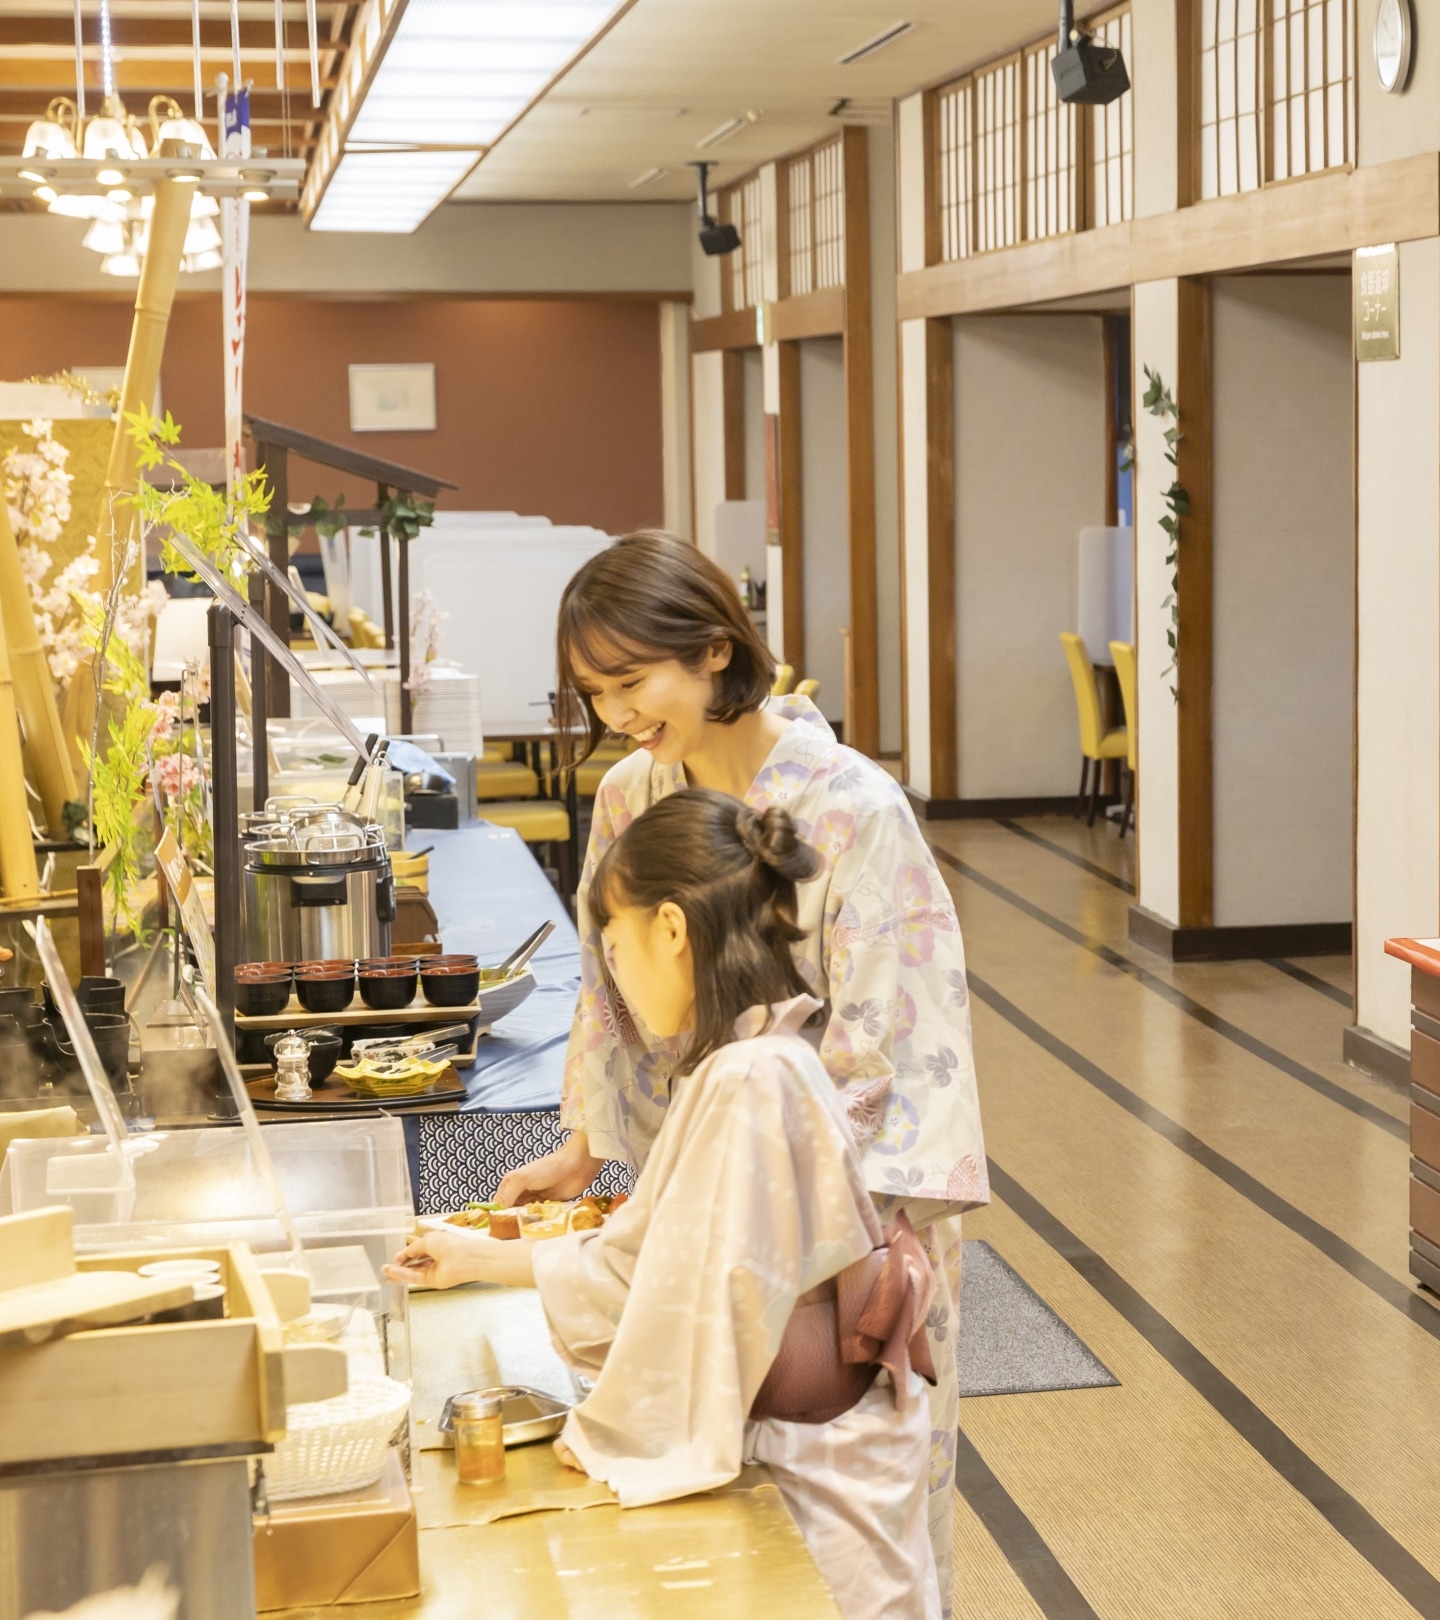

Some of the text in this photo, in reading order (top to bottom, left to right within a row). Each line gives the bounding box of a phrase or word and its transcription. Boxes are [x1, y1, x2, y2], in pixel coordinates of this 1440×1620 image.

[1360, 269, 1390, 297] 食器返却
[1362, 298, 1388, 322] コーナー
